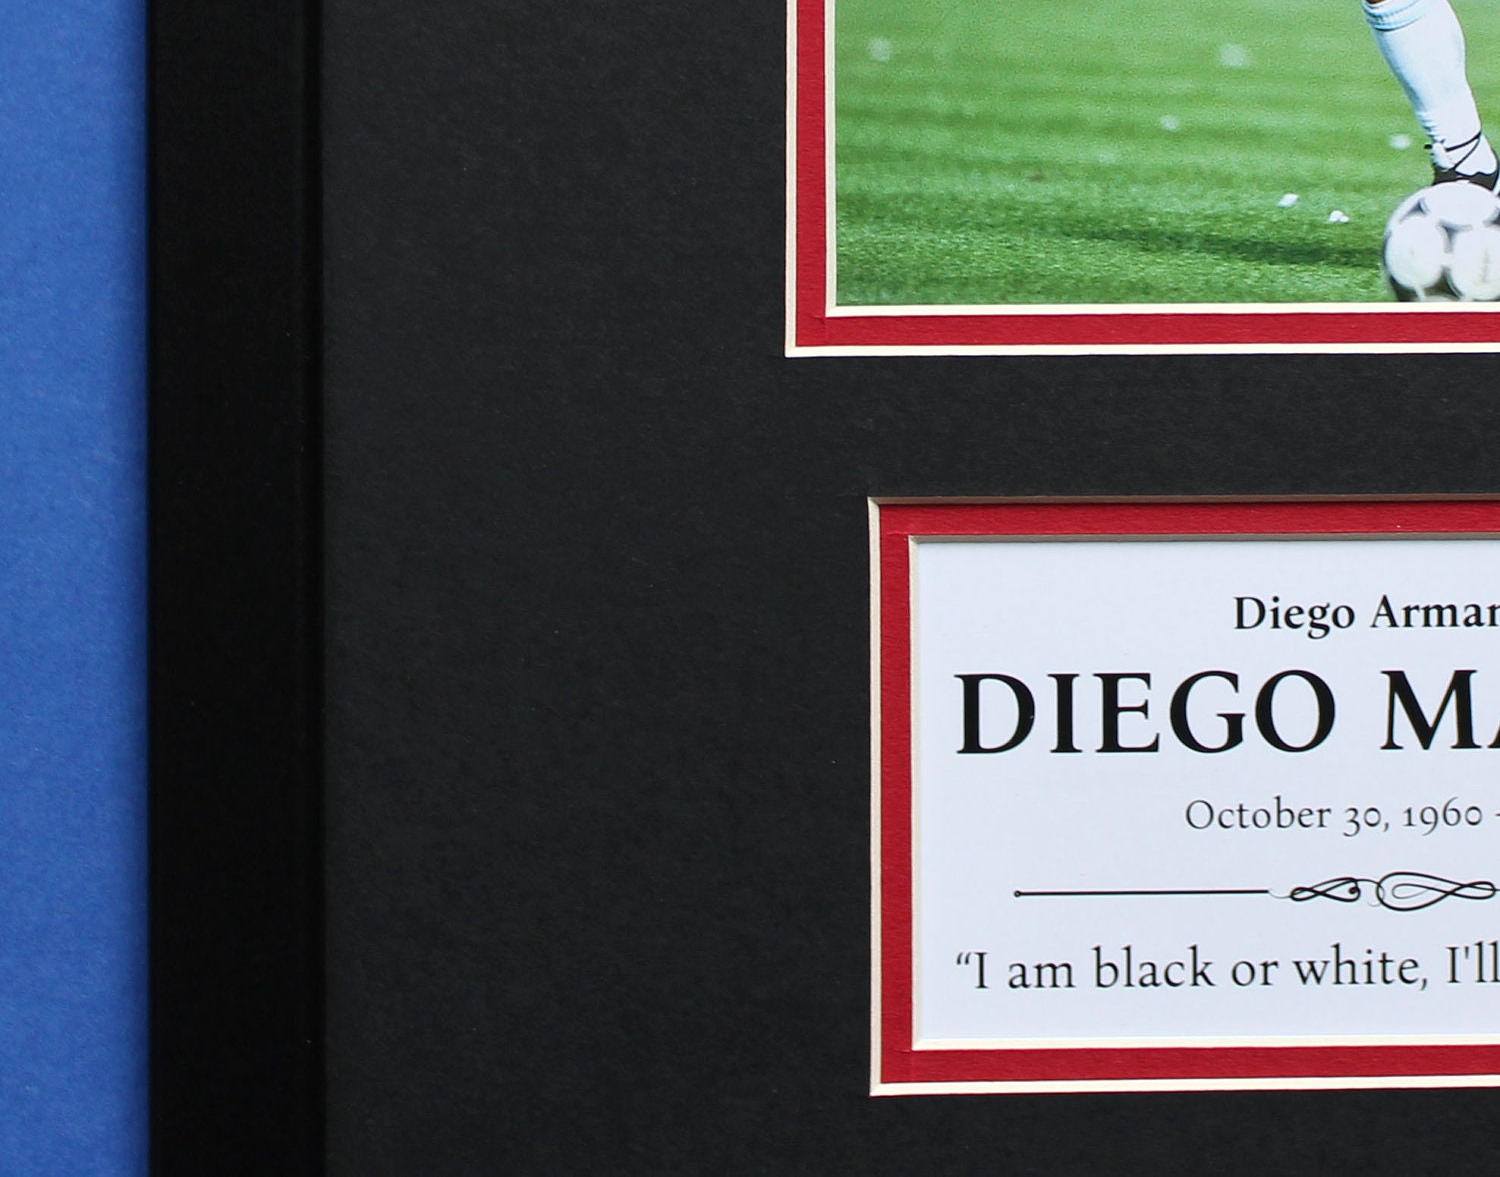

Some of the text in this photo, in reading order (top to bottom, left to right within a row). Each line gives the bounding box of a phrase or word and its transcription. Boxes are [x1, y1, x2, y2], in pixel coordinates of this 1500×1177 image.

[1235, 595, 1355, 640] Diego
[954, 670, 1335, 754] DIEGO
[1185, 795, 1332, 830] October
[1343, 807, 1390, 838] 30,
[1404, 797, 1483, 836] 1960
[955, 951, 989, 989] “I
[1008, 962, 1076, 990] am
[1091, 944, 1216, 989] black
[1231, 960, 1279, 987] or
[1292, 942, 1428, 991] white,
